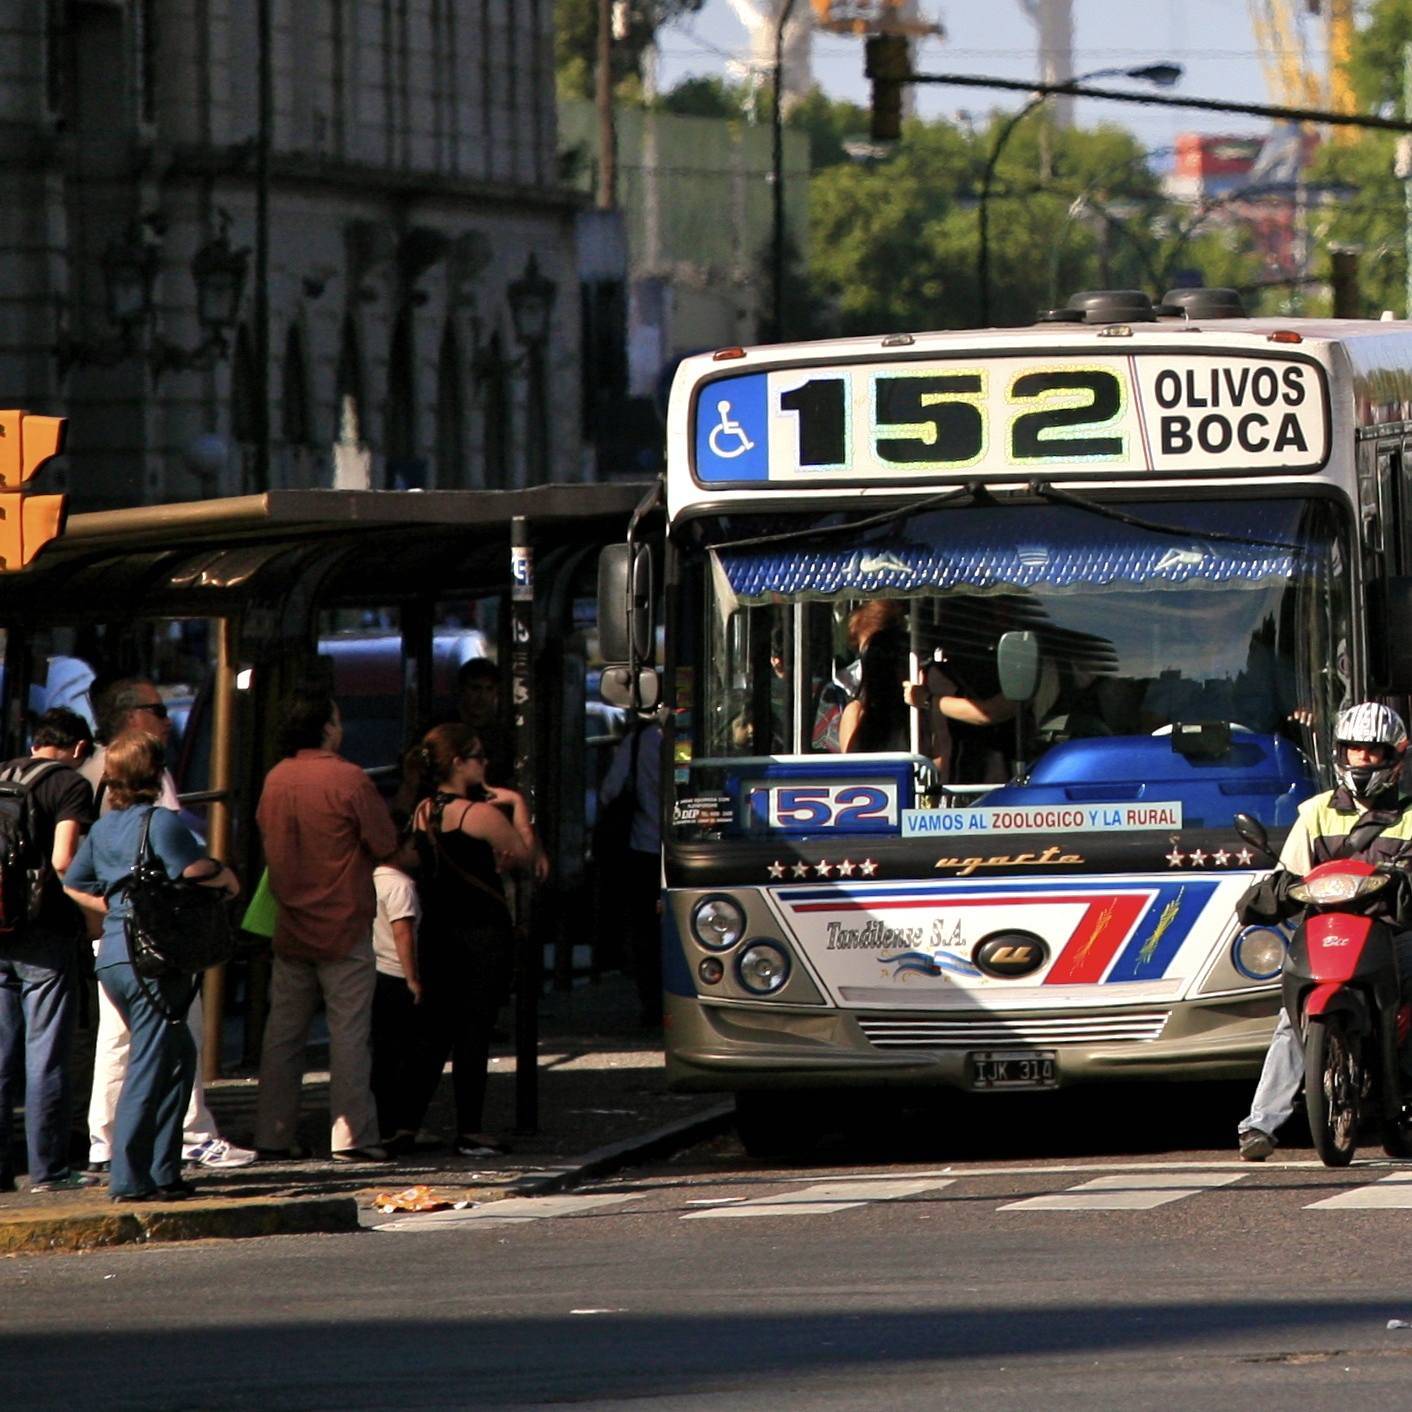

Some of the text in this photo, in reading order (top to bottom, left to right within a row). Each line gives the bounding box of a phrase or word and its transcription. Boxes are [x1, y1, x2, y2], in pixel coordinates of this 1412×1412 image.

[1155, 366, 1306, 408] OLIVOS
[779, 369, 1127, 469] 152
[1161, 412, 1308, 455] BOCA
[745, 787, 889, 826] 152
[908, 808, 1177, 831] VAMOS AL ZOOLOGICO Y LA RURAL
[826, 919, 923, 950] Tandilense
[976, 1062, 1008, 1081] IJK
